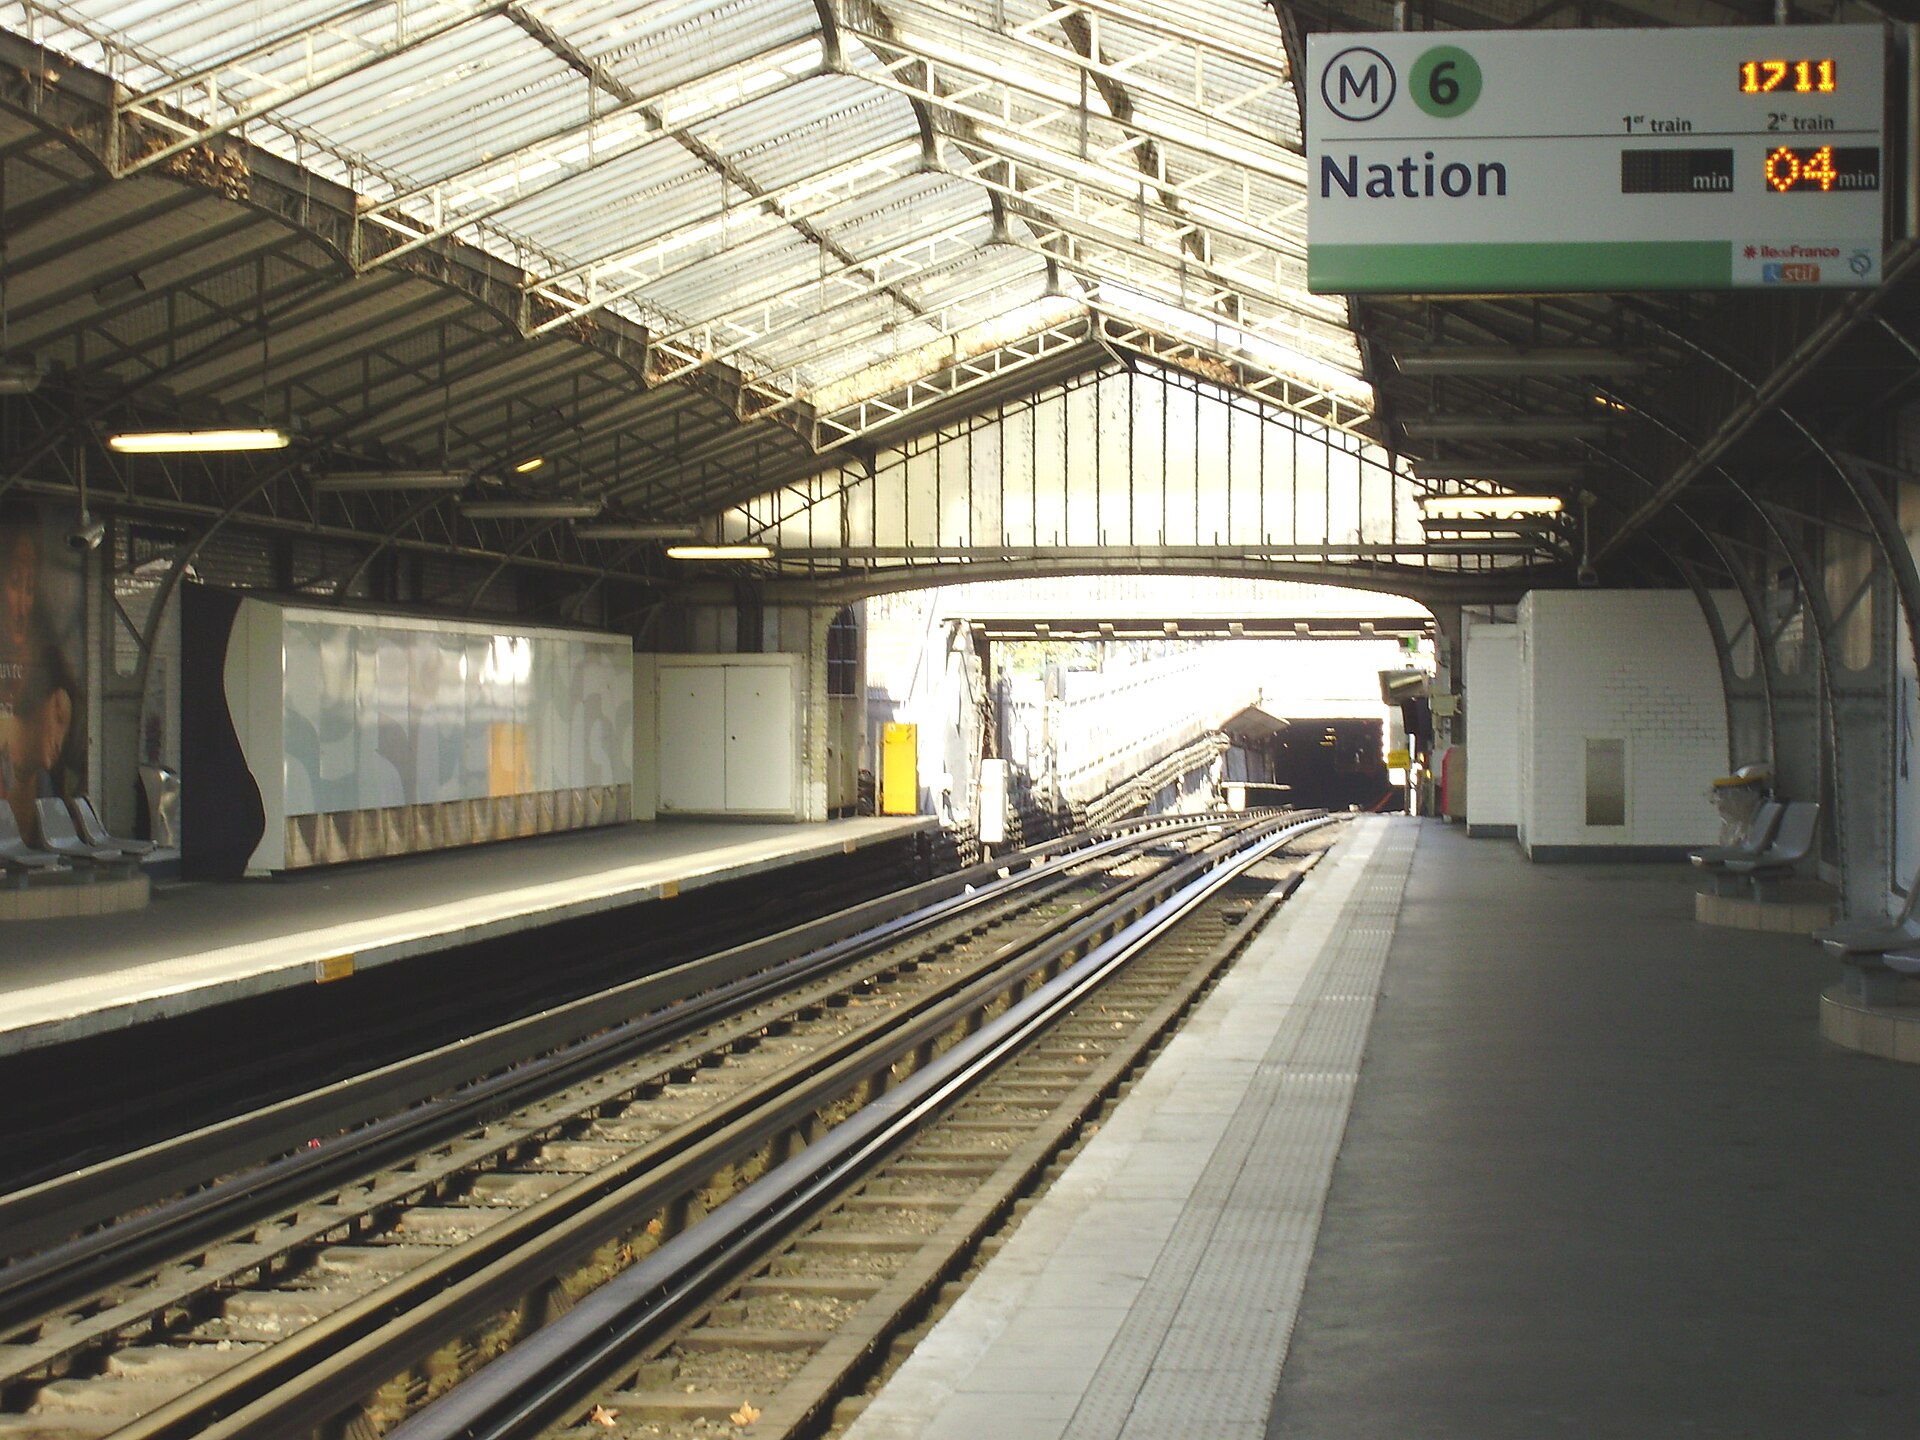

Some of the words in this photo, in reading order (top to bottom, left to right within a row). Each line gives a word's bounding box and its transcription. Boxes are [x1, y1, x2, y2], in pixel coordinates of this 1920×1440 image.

[1339, 64, 1378, 104] M
[1428, 60, 1460, 106] 6
[1650, 116, 1692, 133] train
[1793, 113, 1835, 131] train
[1320, 151, 1507, 198] Nation
[1764, 145, 1838, 192] 04
[1693, 171, 1730, 189] min
[1838, 169, 1876, 187] min
